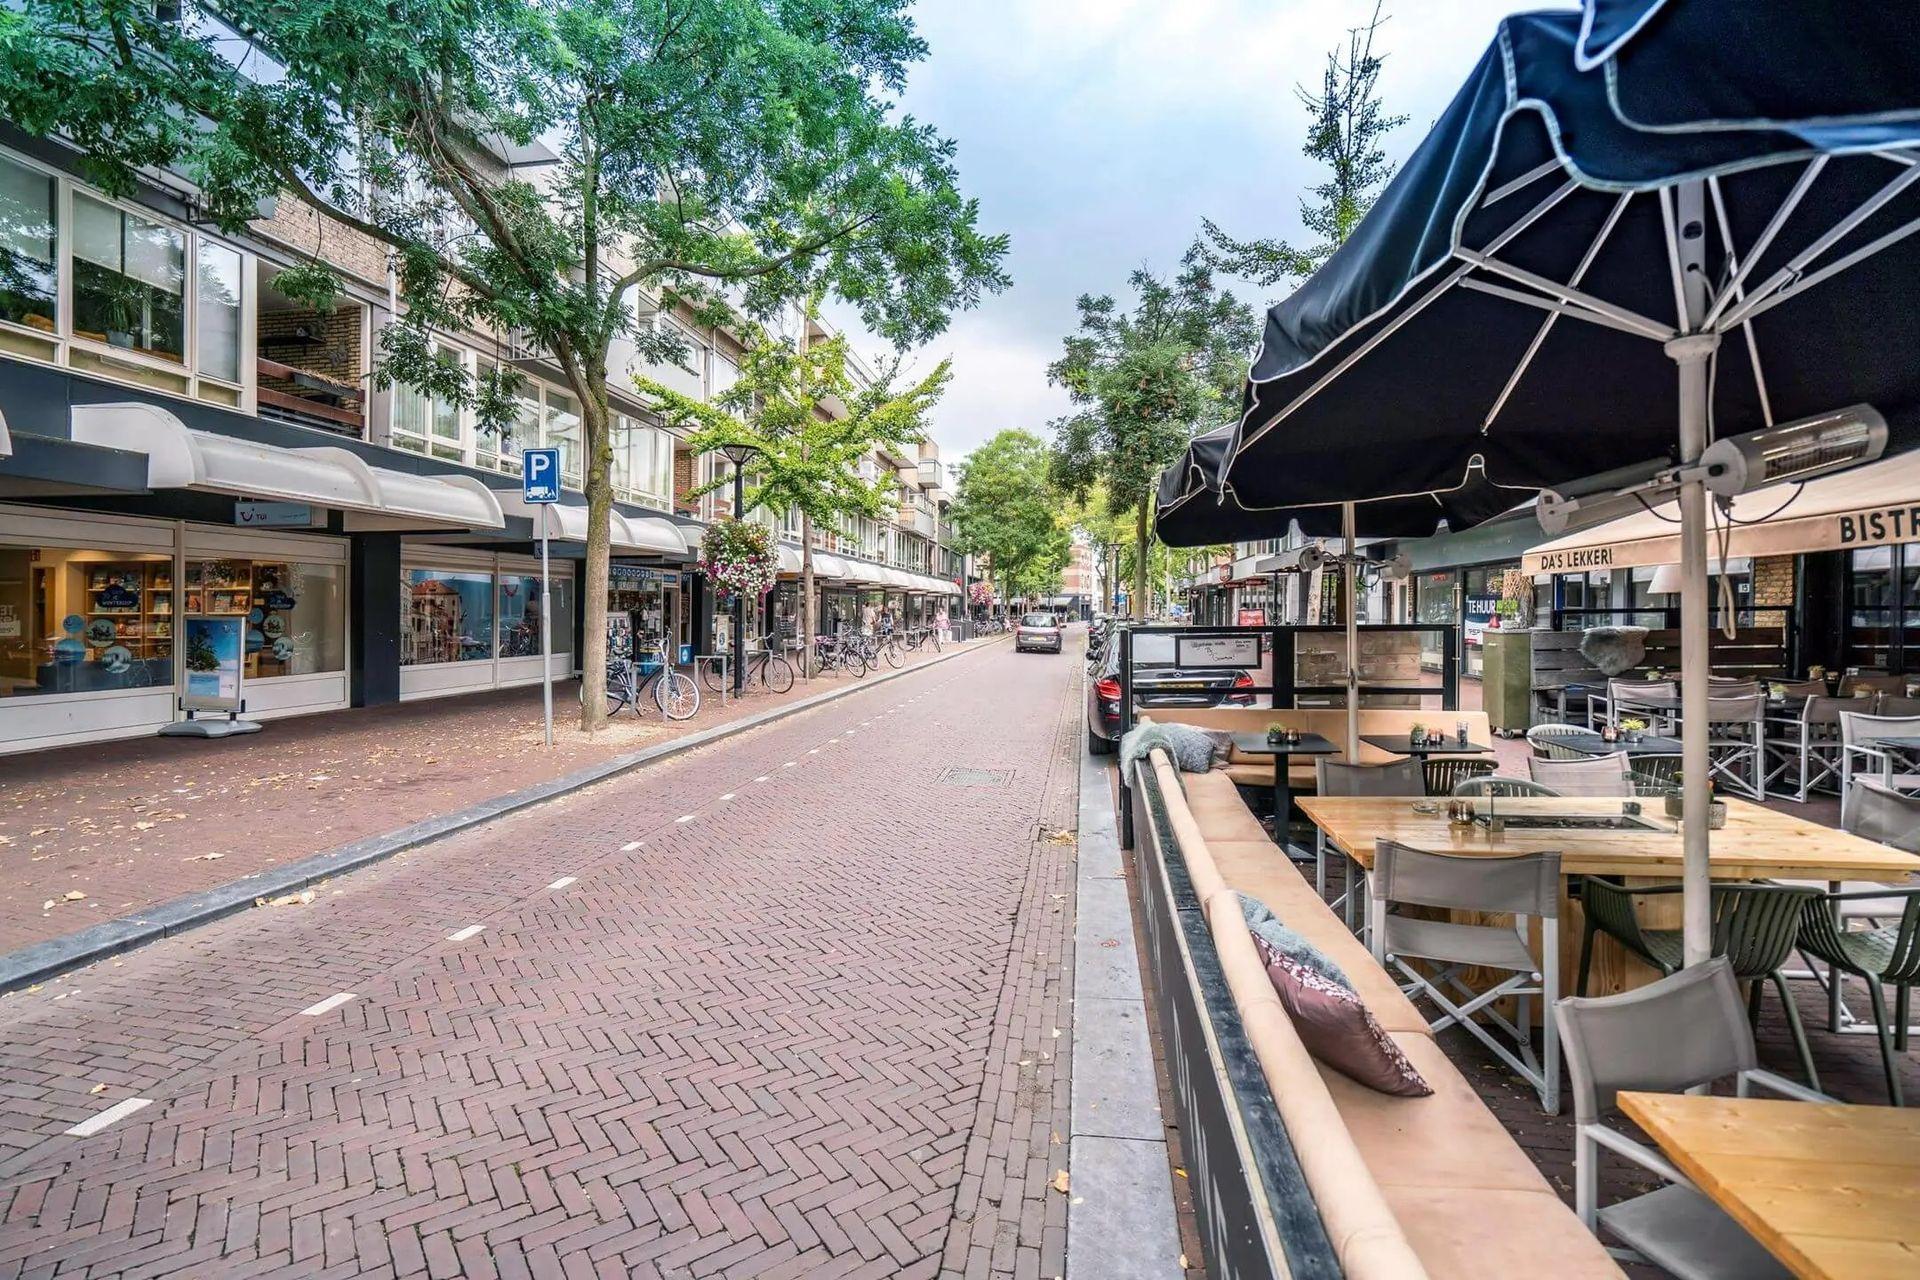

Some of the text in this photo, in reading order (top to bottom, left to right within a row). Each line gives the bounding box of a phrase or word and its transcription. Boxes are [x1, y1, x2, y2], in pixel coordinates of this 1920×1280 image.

[531, 454, 550, 480] P
[1840, 508, 1920, 543] BISTR
[1541, 554, 1562, 569] DA'S
[1468, 600, 1476, 613] TE
[1476, 600, 1495, 613] HUUR
